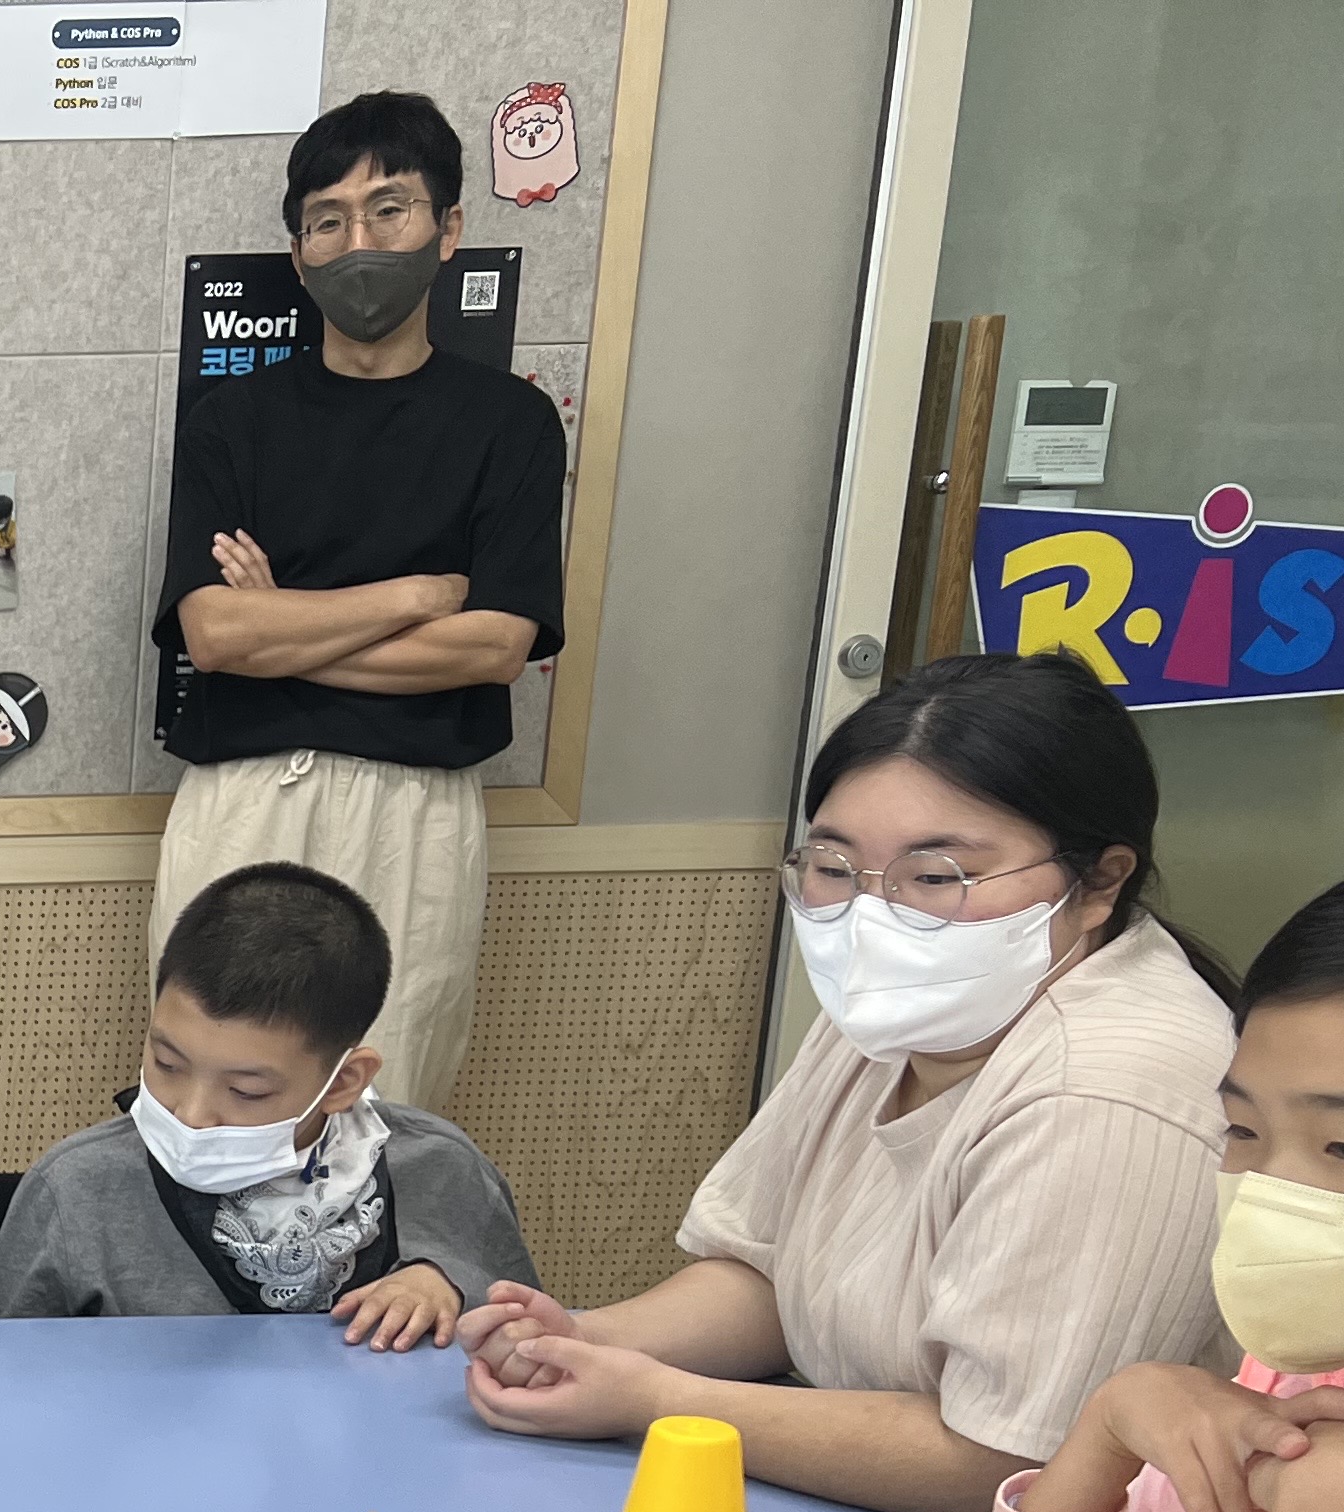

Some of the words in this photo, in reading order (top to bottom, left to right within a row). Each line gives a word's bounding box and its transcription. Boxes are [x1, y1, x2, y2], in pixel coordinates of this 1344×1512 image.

[70, 28, 109, 42] Python
[111, 28, 118, 39] &
[120, 28, 141, 39] COS
[143, 27, 162, 38] Pro
[56, 57, 80, 69] COS
[83, 56, 97, 69] 1급
[101, 55, 197, 69] (Scratch&Algorithm)
[55, 77, 93, 91] Python
[96, 76, 118, 89] 입문
[53, 98, 77, 109] COS
[79, 98, 98, 109] Pro
[100, 96, 117, 109] 2급
[120, 96, 143, 109] 대비
[204, 282, 243, 298] 2022
[203, 308, 298, 339] Woori
[200, 346, 256, 377] 코딩
